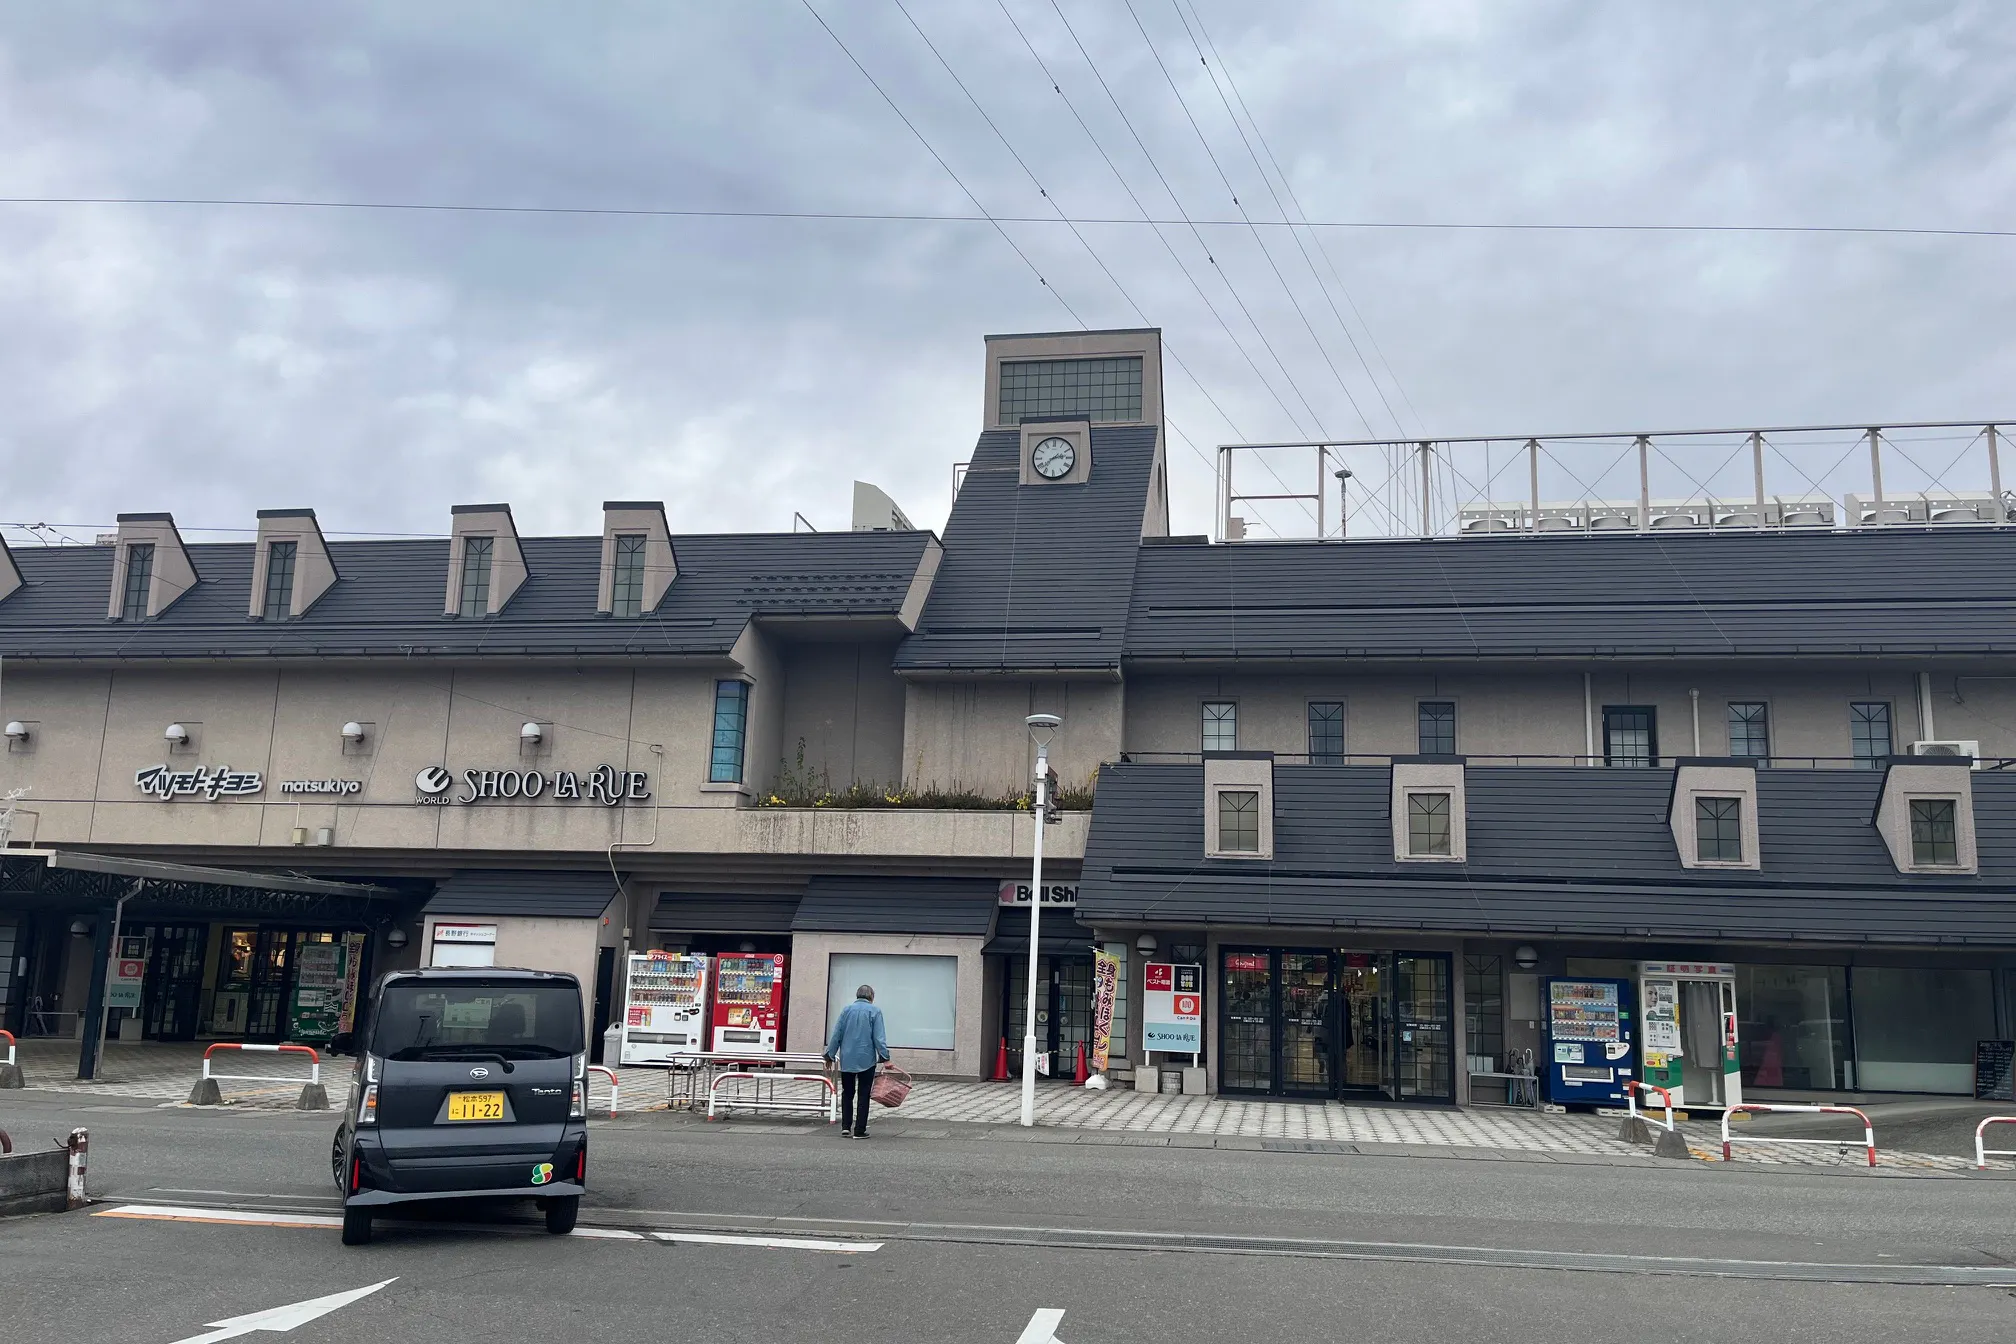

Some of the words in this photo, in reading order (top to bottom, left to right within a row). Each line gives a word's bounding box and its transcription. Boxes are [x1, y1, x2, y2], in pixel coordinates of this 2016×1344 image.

[136, 766, 261, 799] マツモトキヨシ
[280, 779, 361, 794] matsukiyo
[415, 796, 450, 804] WORLD
[1666, 965, 1717, 974] 証明写真
[1156, 1032, 1175, 1041] SHOO
[531, 1088, 562, 1096] Tanto
[478, 1094, 492, 1103] 597
[462, 1103, 501, 1118] 11-22
